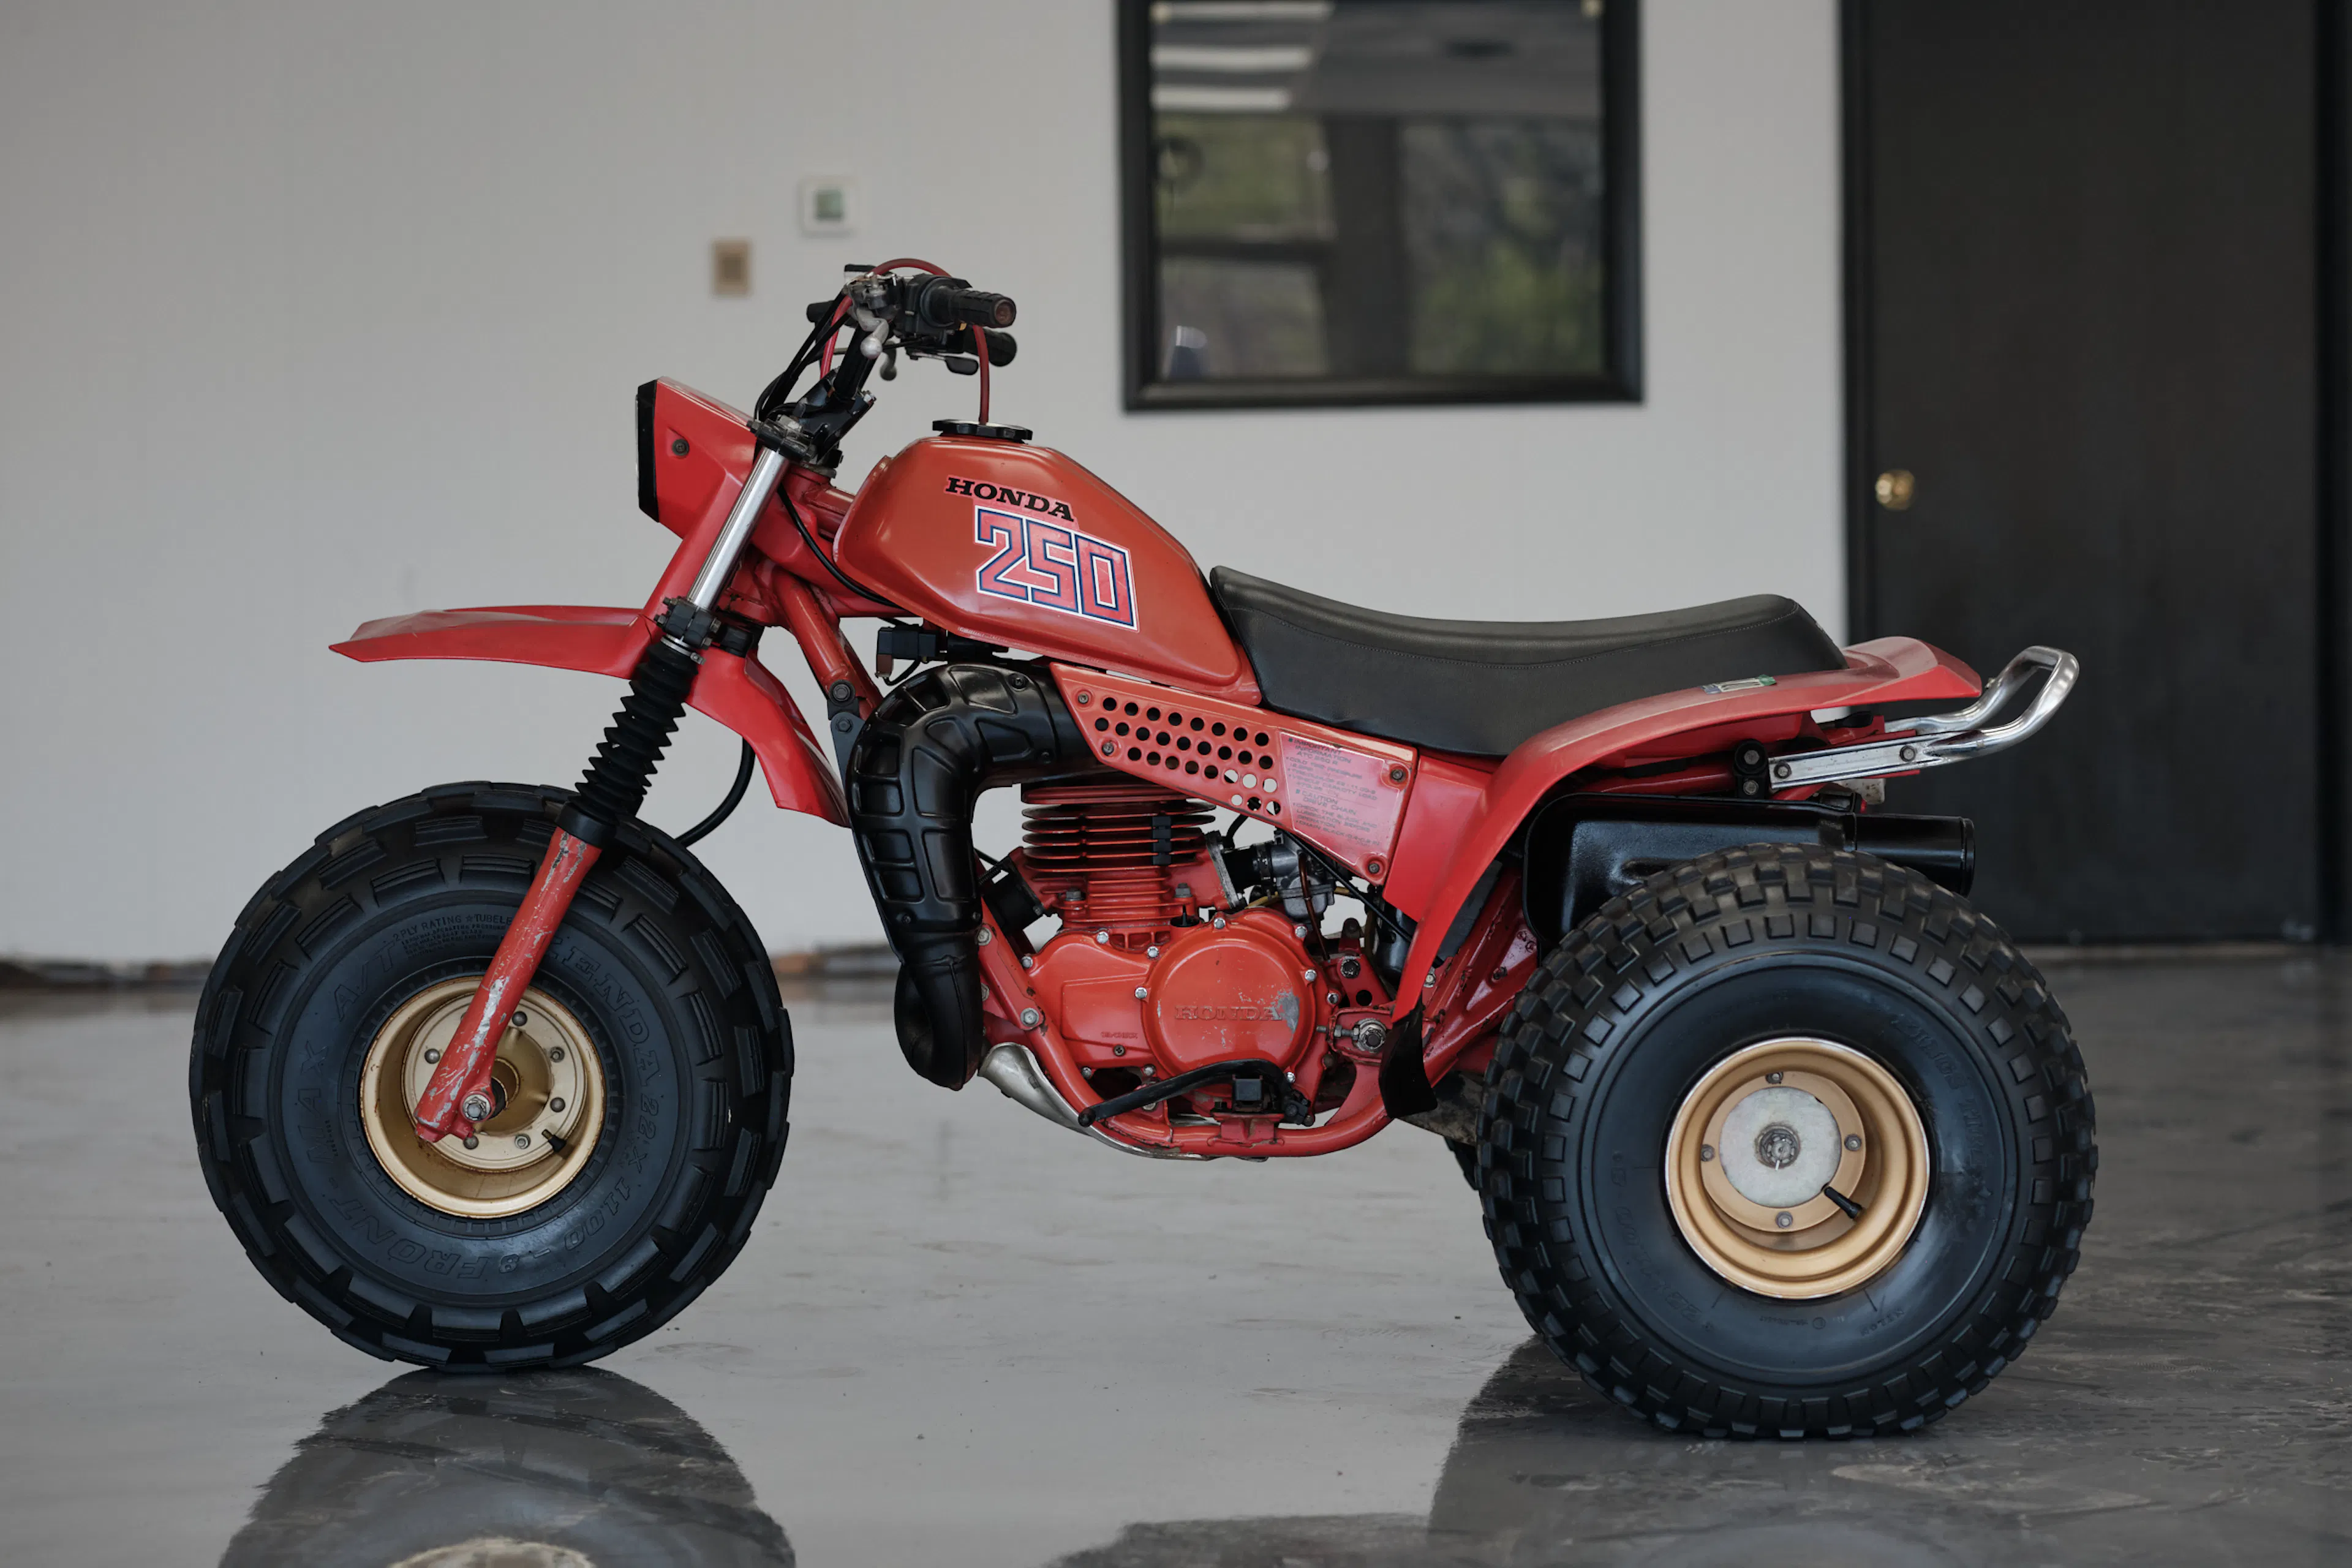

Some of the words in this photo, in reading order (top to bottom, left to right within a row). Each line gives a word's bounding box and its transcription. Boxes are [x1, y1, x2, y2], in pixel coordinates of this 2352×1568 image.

[945, 477, 1074, 522] HONDA
[974, 505, 1138, 631] 250
[1294, 739, 1341, 755] IMPORTANT
[1295, 745, 1352, 763] INFORMATION
[1302, 790, 1338, 804] CAUTION
[1297, 815, 1335, 827] OPERATION
[1331, 805, 1357, 815] CHAIN
[393, 933, 399, 942] 2
[400, 925, 417, 938] PLY
[421, 914, 462, 930] RATING
[334, 940, 395, 1022] A/T
[1175, 1005, 1282, 1020] HONDA
[298, 1039, 334, 1163] MAX
[328, 1199, 490, 1278] FRONT
